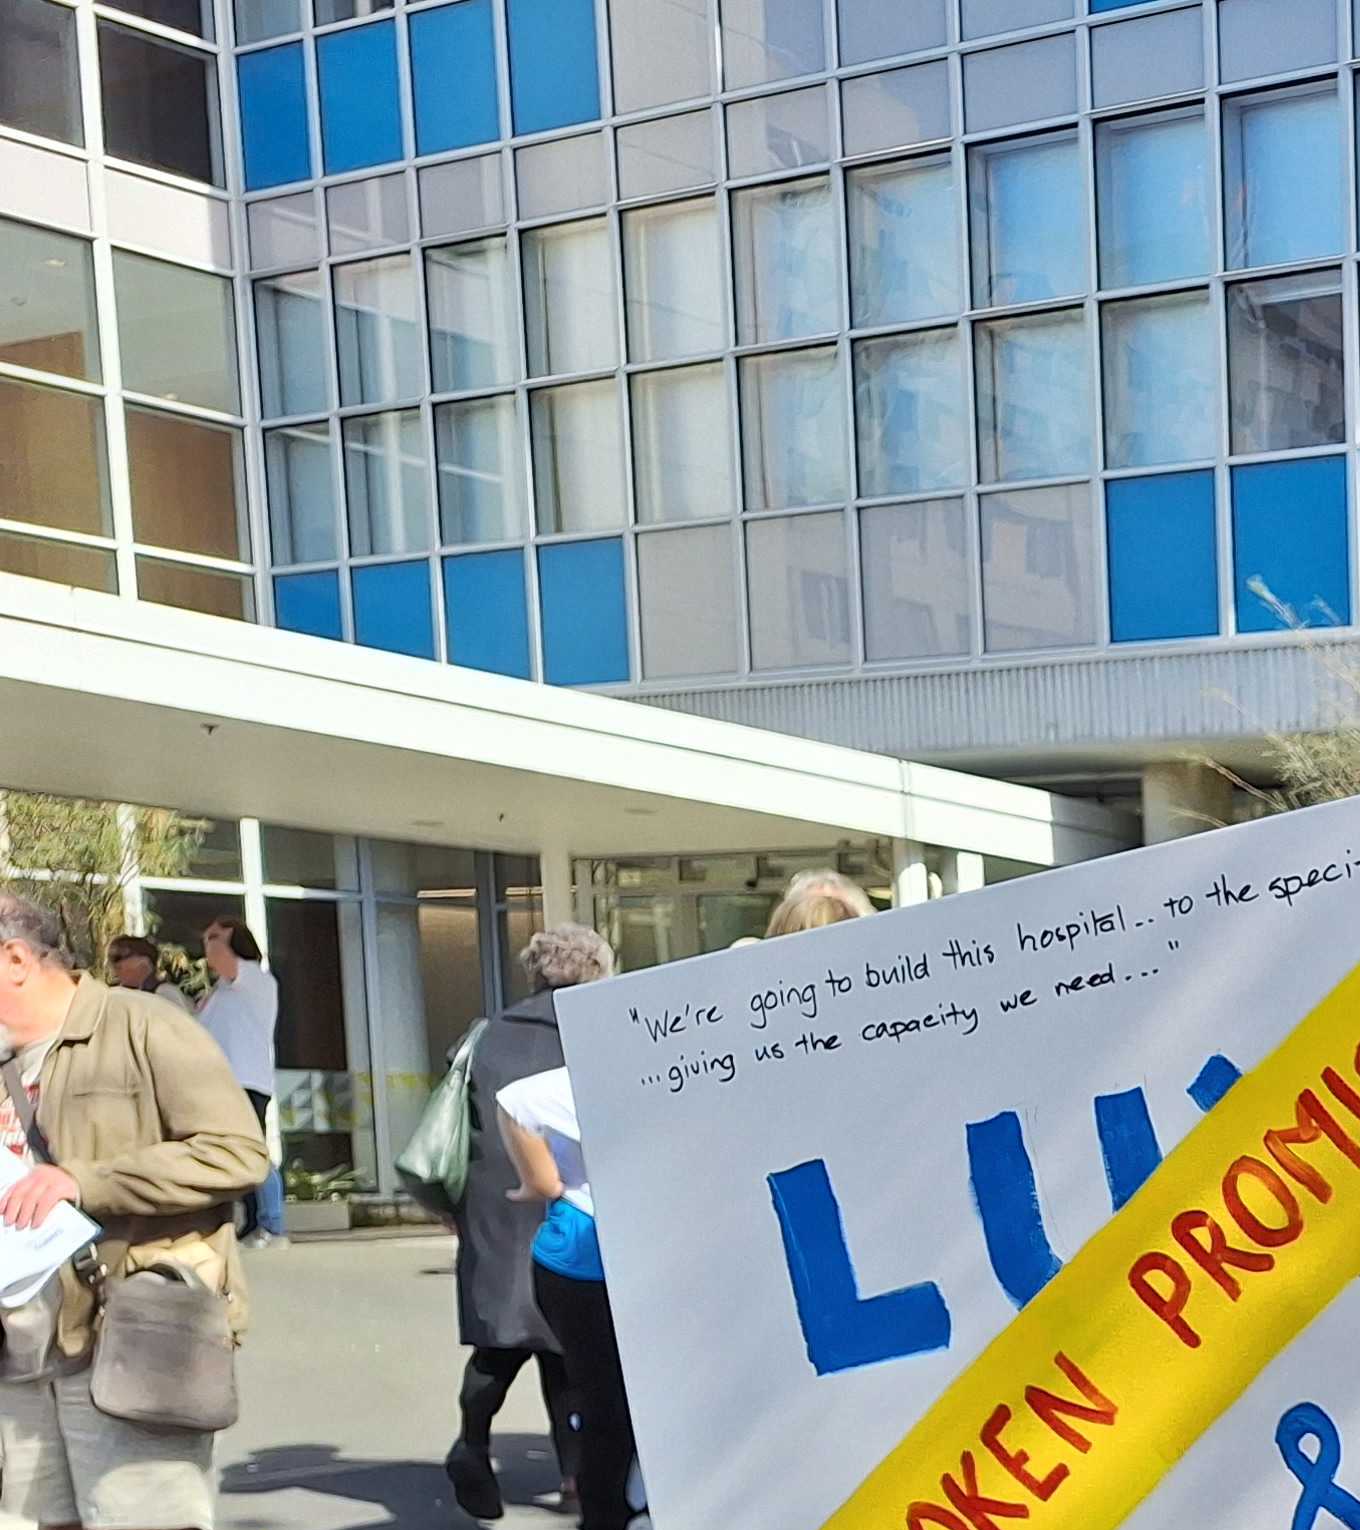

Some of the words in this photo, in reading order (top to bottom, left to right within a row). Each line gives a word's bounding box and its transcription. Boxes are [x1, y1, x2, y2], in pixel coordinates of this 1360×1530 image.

[750, 981, 817, 1029] going
[825, 969, 852, 998] to
[865, 953, 930, 988] build
[942, 939, 995, 970] this
[1164, 895, 1194, 919] to
[1205, 874, 1259, 907] the
[755, 1043, 785, 1062] us
[795, 1032, 842, 1055] the
[861, 1002, 978, 1043] capacity
[1000, 989, 1037, 1013] we
